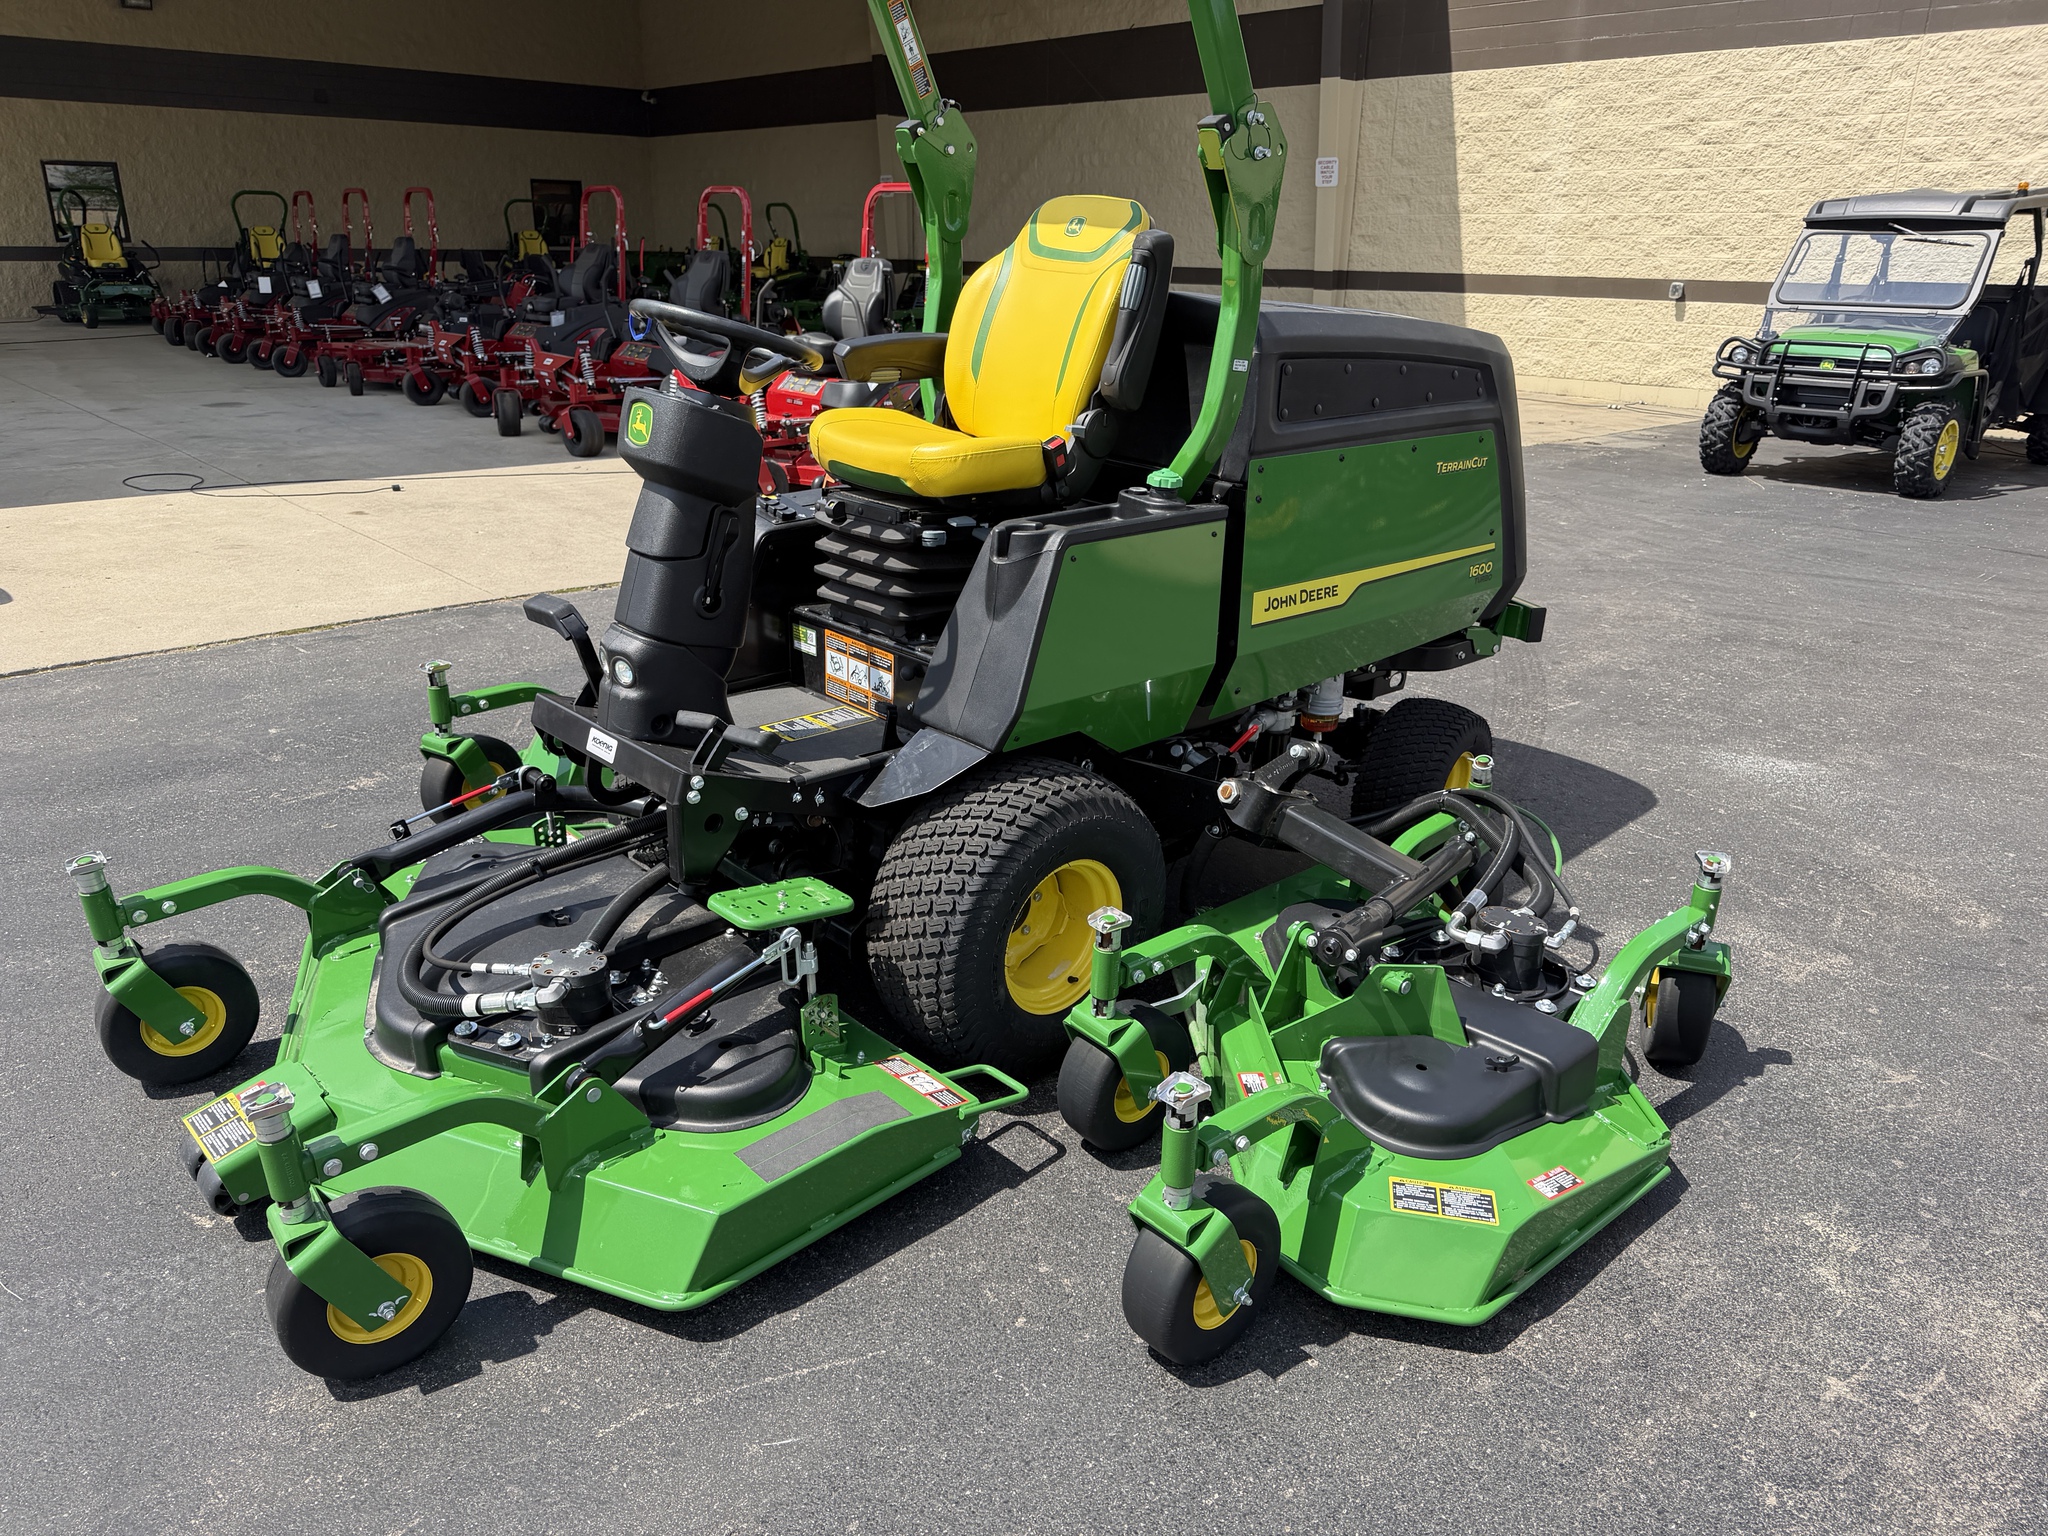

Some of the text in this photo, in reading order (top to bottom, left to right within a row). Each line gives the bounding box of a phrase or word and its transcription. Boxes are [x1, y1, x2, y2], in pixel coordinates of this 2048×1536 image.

[1436, 456, 1489, 474] TERRAINCUT
[1469, 561, 1493, 577] 1600
[1264, 584, 1339, 612] JOHN DEERE
